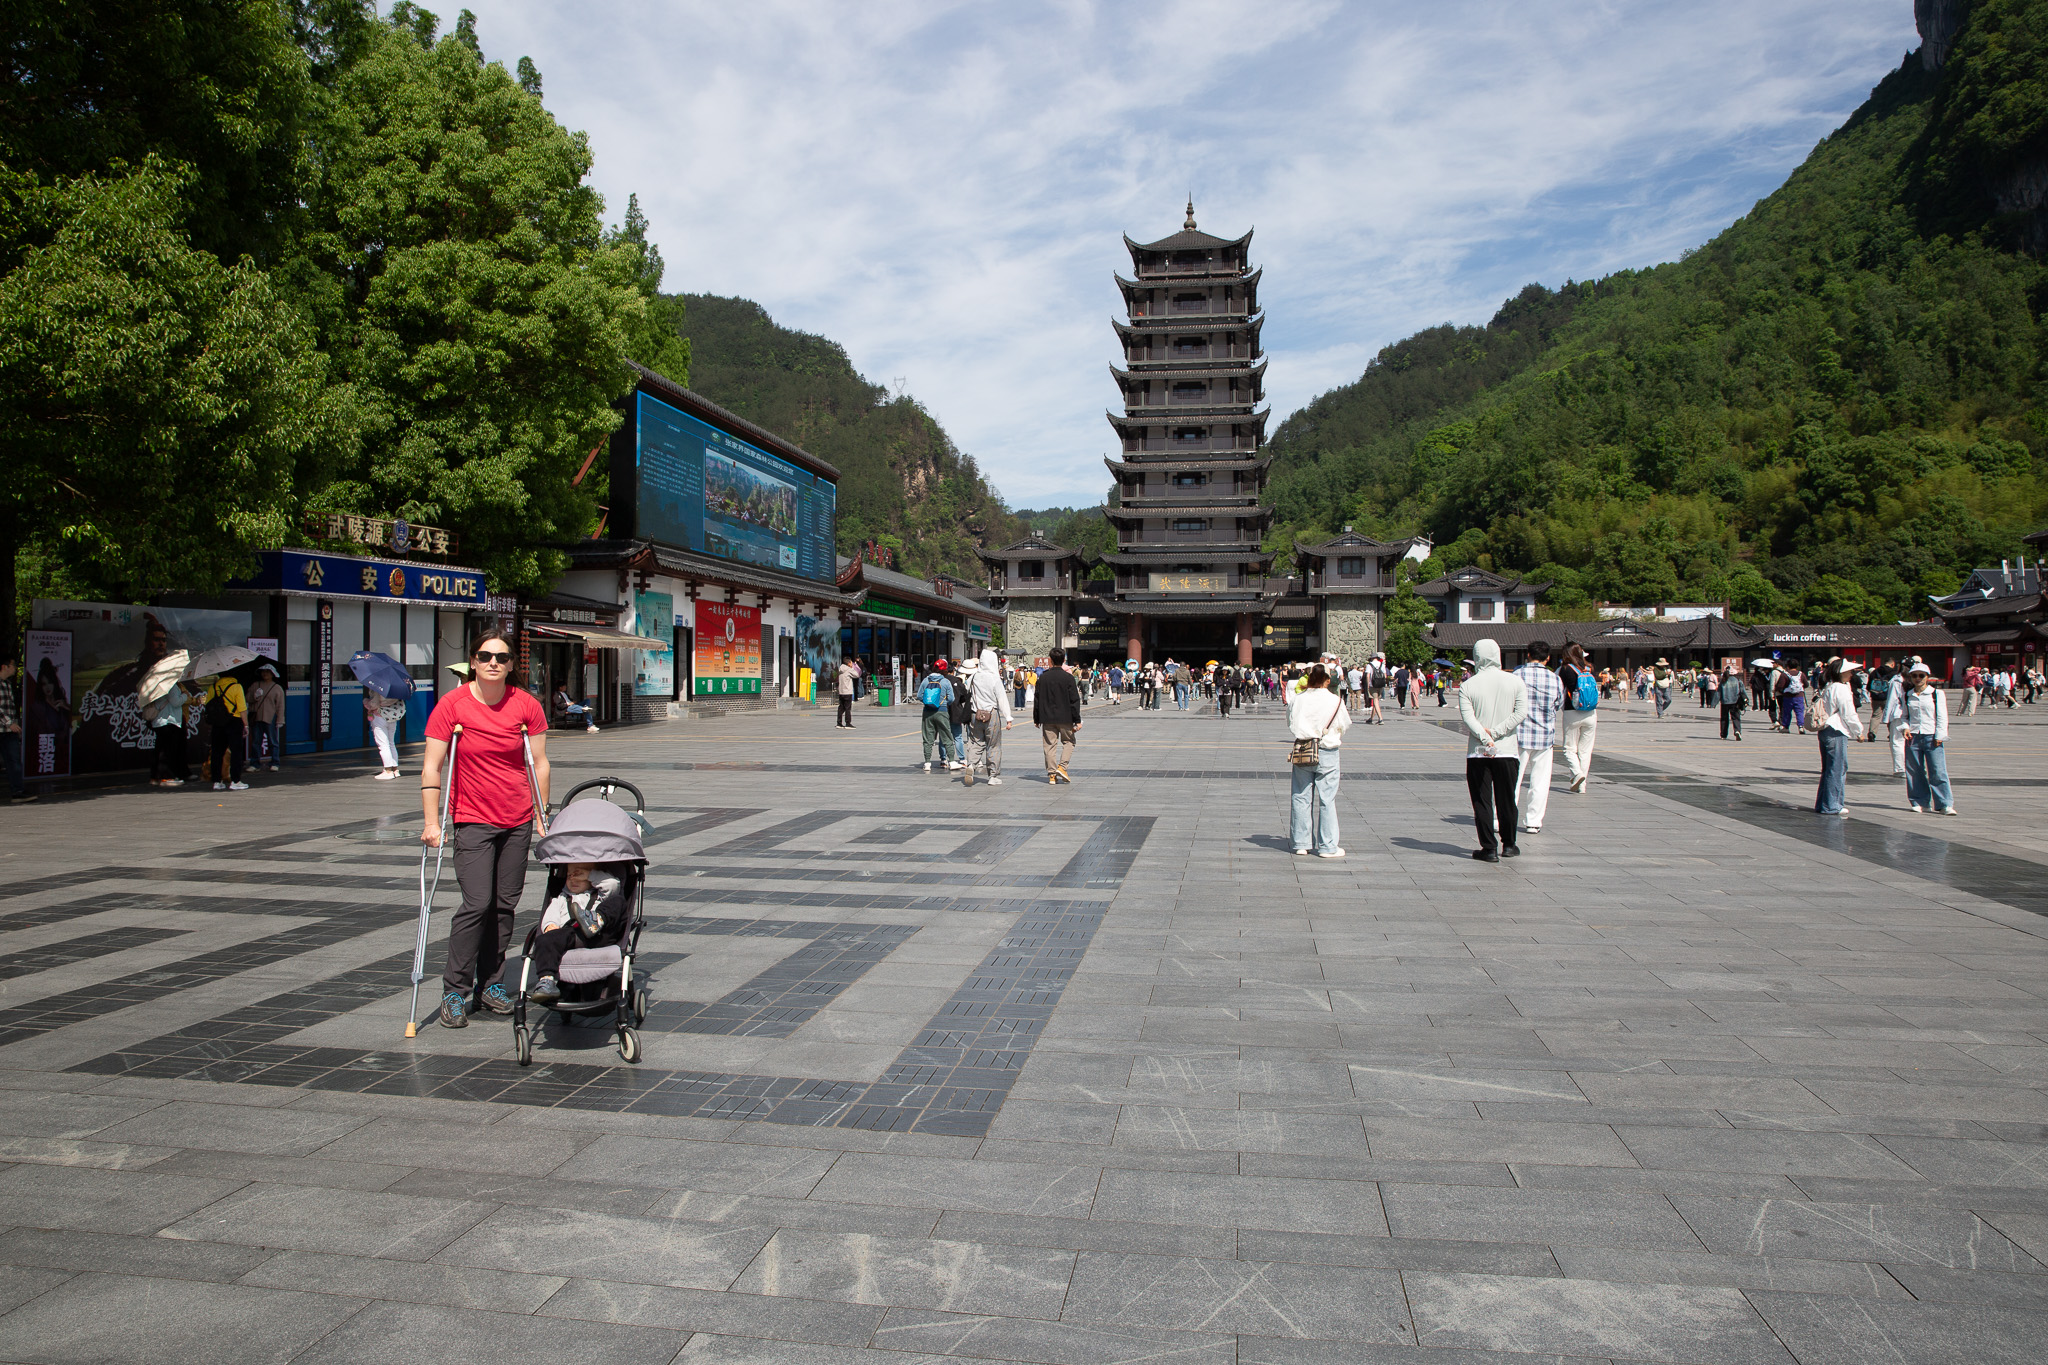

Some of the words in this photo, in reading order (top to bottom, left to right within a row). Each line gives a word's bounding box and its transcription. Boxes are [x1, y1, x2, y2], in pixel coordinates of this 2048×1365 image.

[327, 515, 385, 547] 武陵源
[416, 528, 450, 555] 公安
[305, 560, 378, 591] 公安
[422, 574, 477, 597] POLICE
[487, 596, 517, 613] 自助行李寄存
[561, 609, 596, 623] 中国福利彩票
[1773, 633, 1799, 642] luckin
[1800, 633, 1827, 642] coffee
[38, 733, 55, 773] 甄洛
